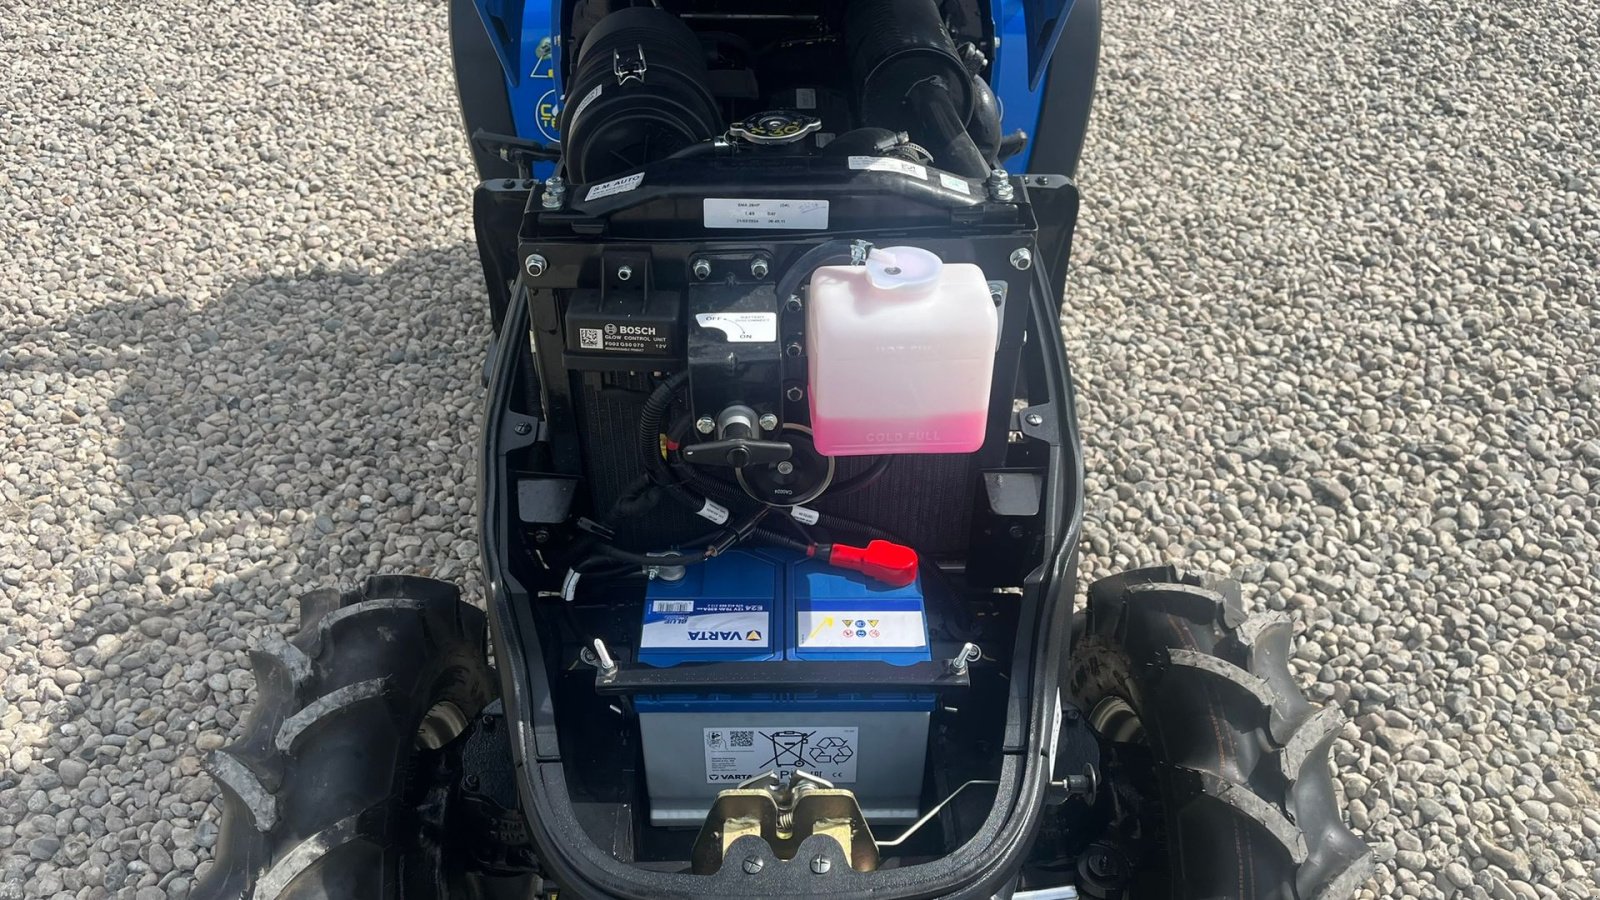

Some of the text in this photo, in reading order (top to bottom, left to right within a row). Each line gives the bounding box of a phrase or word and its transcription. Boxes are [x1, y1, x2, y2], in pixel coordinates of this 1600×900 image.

[613, 175, 640, 186] AUTO
[619, 325, 656, 335] BOSCH
[865, 431, 941, 442] COLD FULL
[688, 631, 743, 641] VARTA
